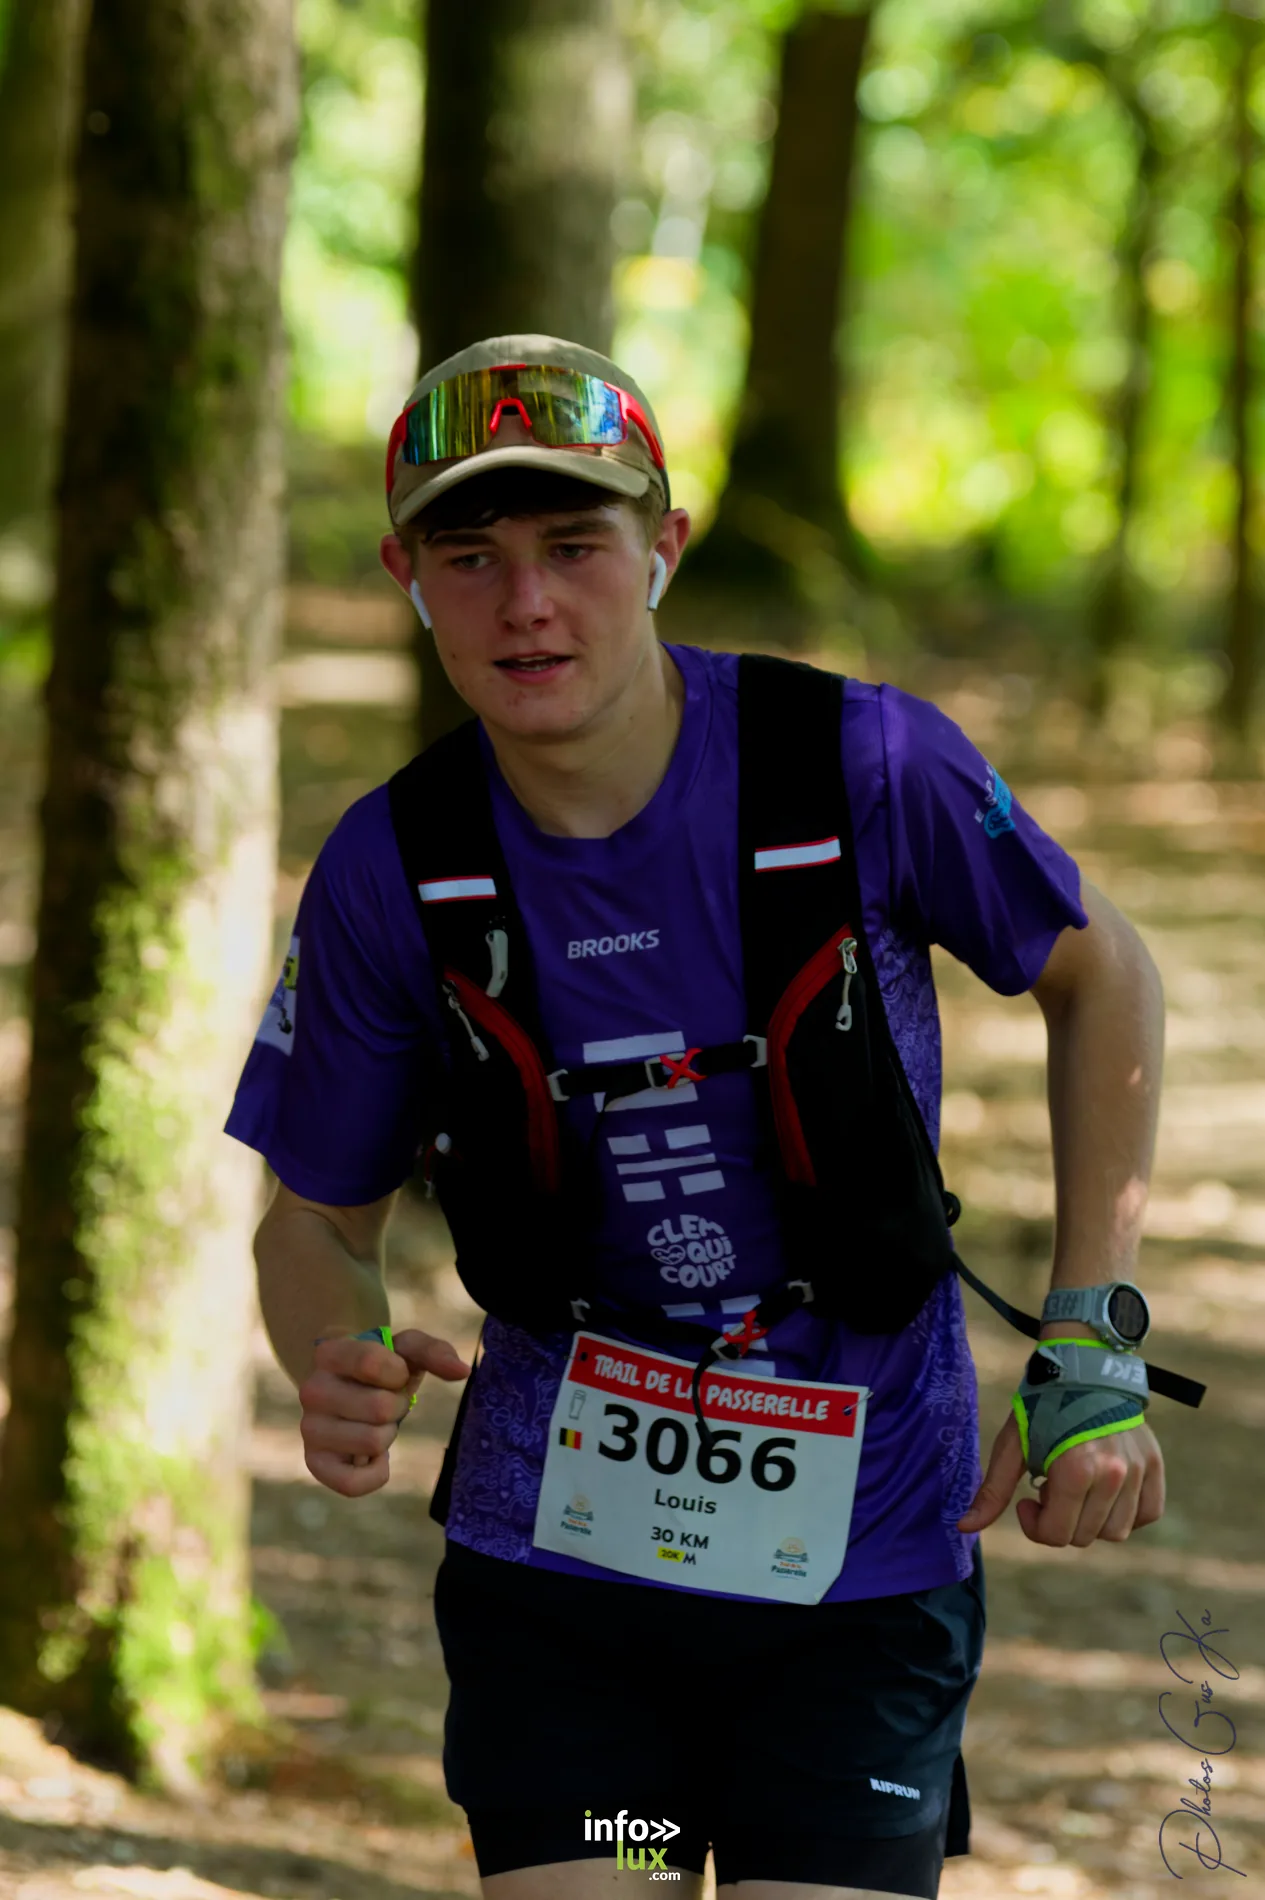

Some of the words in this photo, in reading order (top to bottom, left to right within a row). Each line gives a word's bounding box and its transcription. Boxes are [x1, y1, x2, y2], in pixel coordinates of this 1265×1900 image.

[567, 929, 660, 959] BROOKS
[647, 1214, 725, 1246] CLEM
[660, 1254, 737, 1288] COURT
[594, 1354, 640, 1387] TRAIL
[645, 1370, 672, 1393] DE
[706, 1384, 829, 1421] PASSERELLE
[598, 1404, 797, 1492] 3066
[654, 1489, 717, 1514] Louis
[650, 1526, 675, 1543] 30
[680, 1532, 710, 1549] KM
[869, 1777, 921, 1801] KIPRUN
